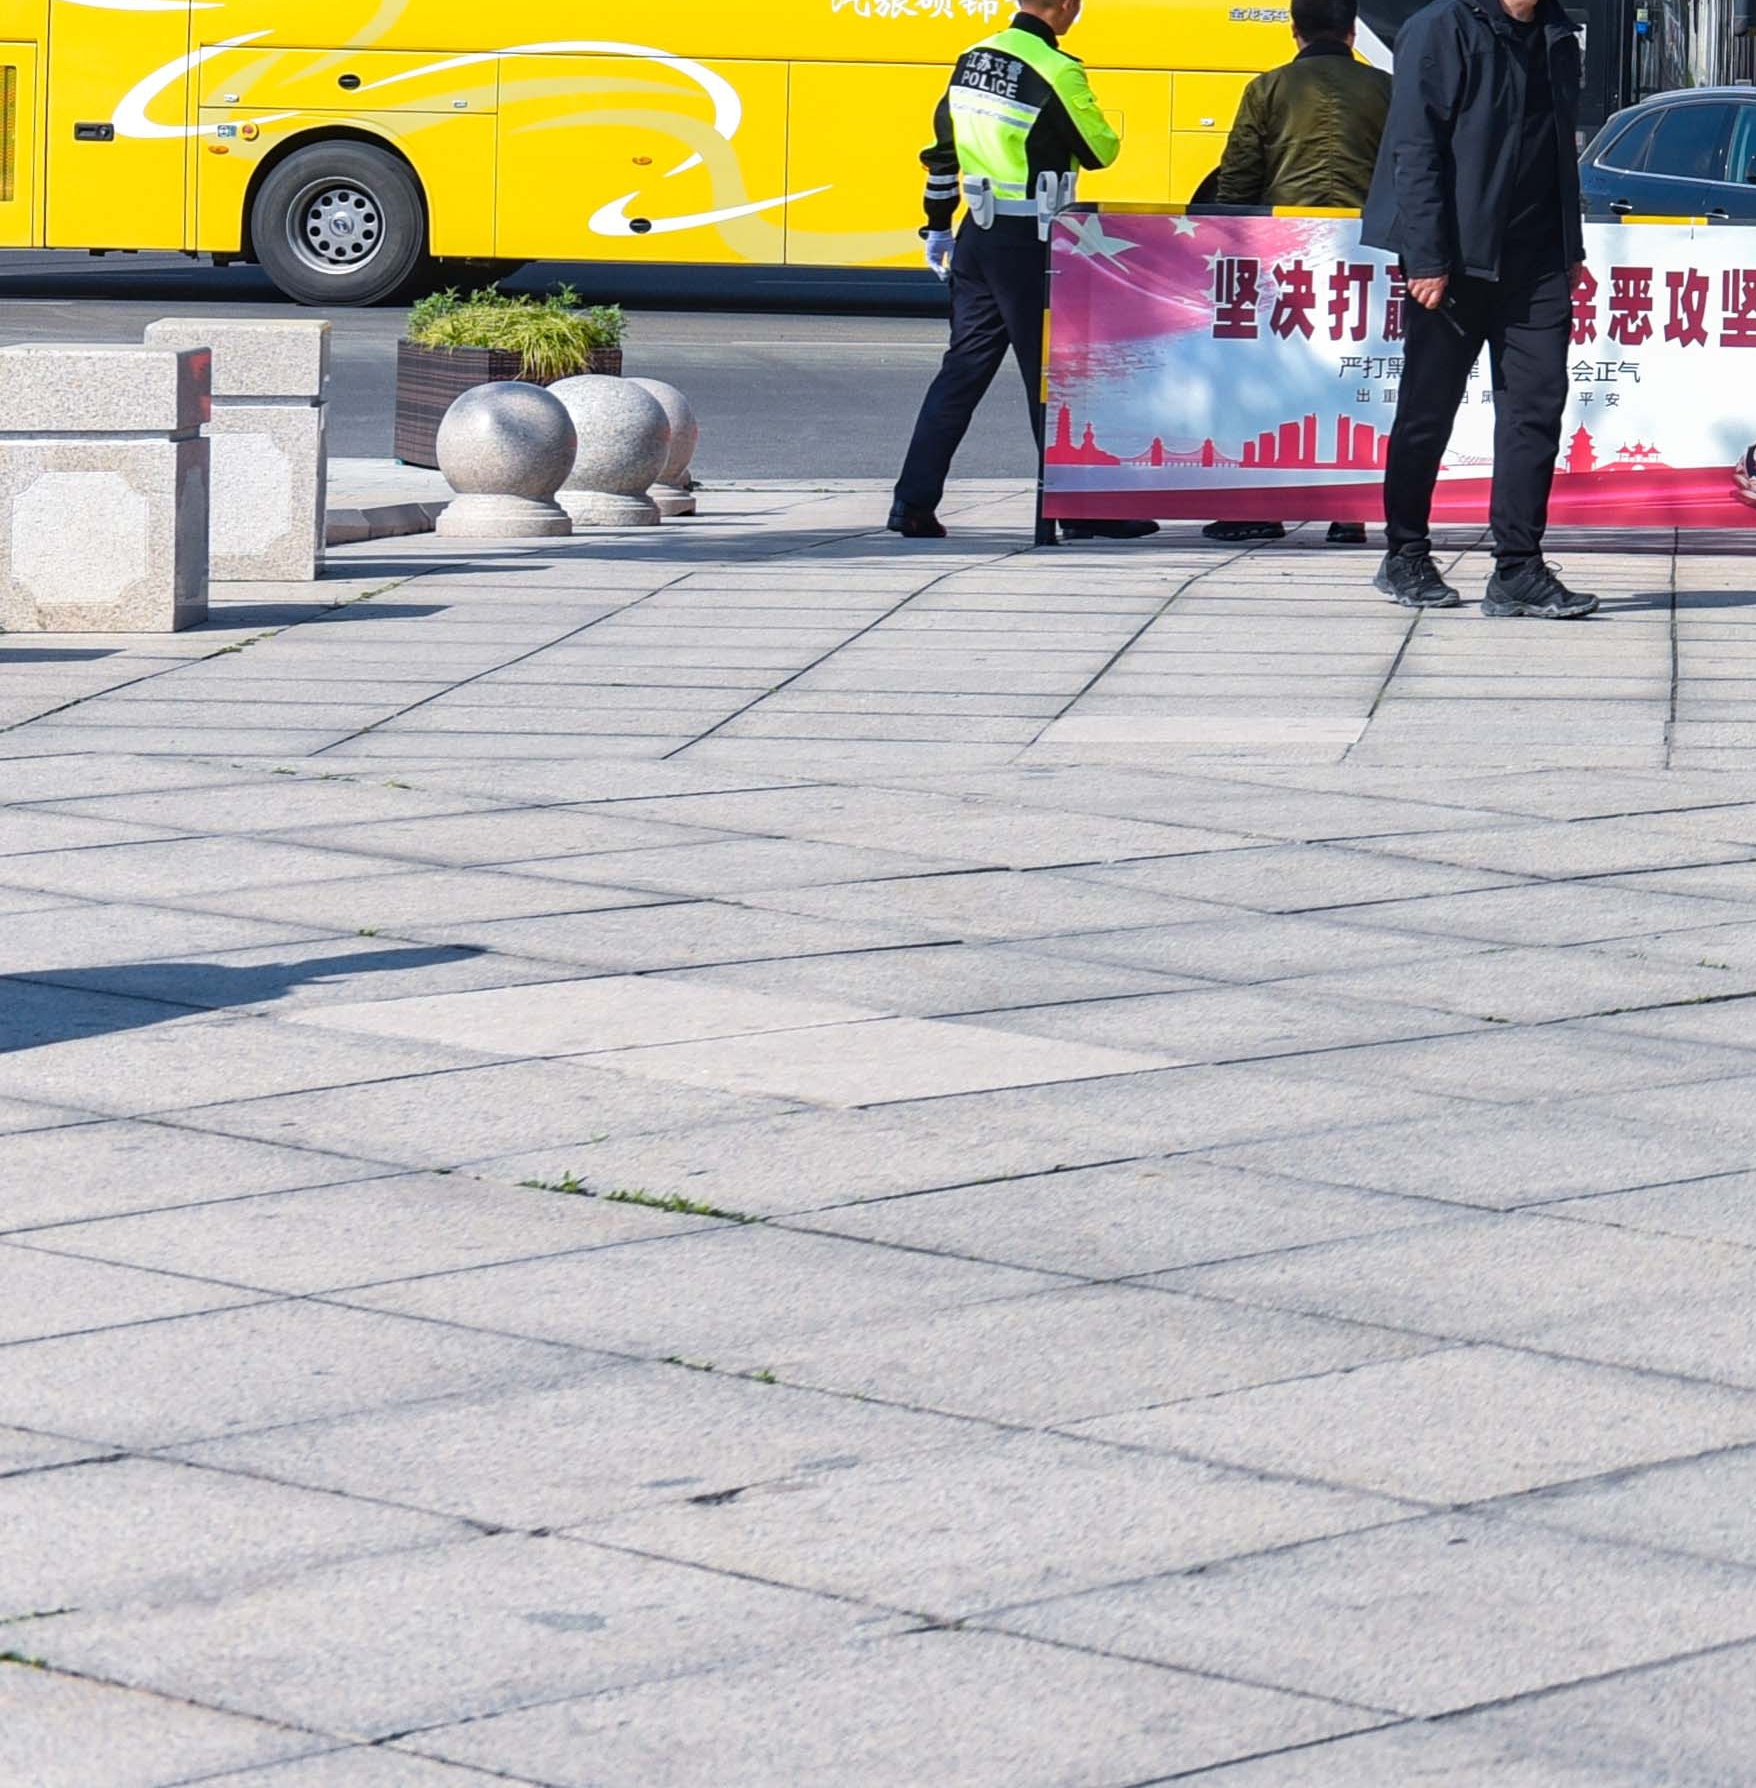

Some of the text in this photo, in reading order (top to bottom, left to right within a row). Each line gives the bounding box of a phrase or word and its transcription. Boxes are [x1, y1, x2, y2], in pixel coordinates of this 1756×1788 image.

[966, 51, 1024, 82] 江苏交警
[961, 70, 1018, 99] POLICE
